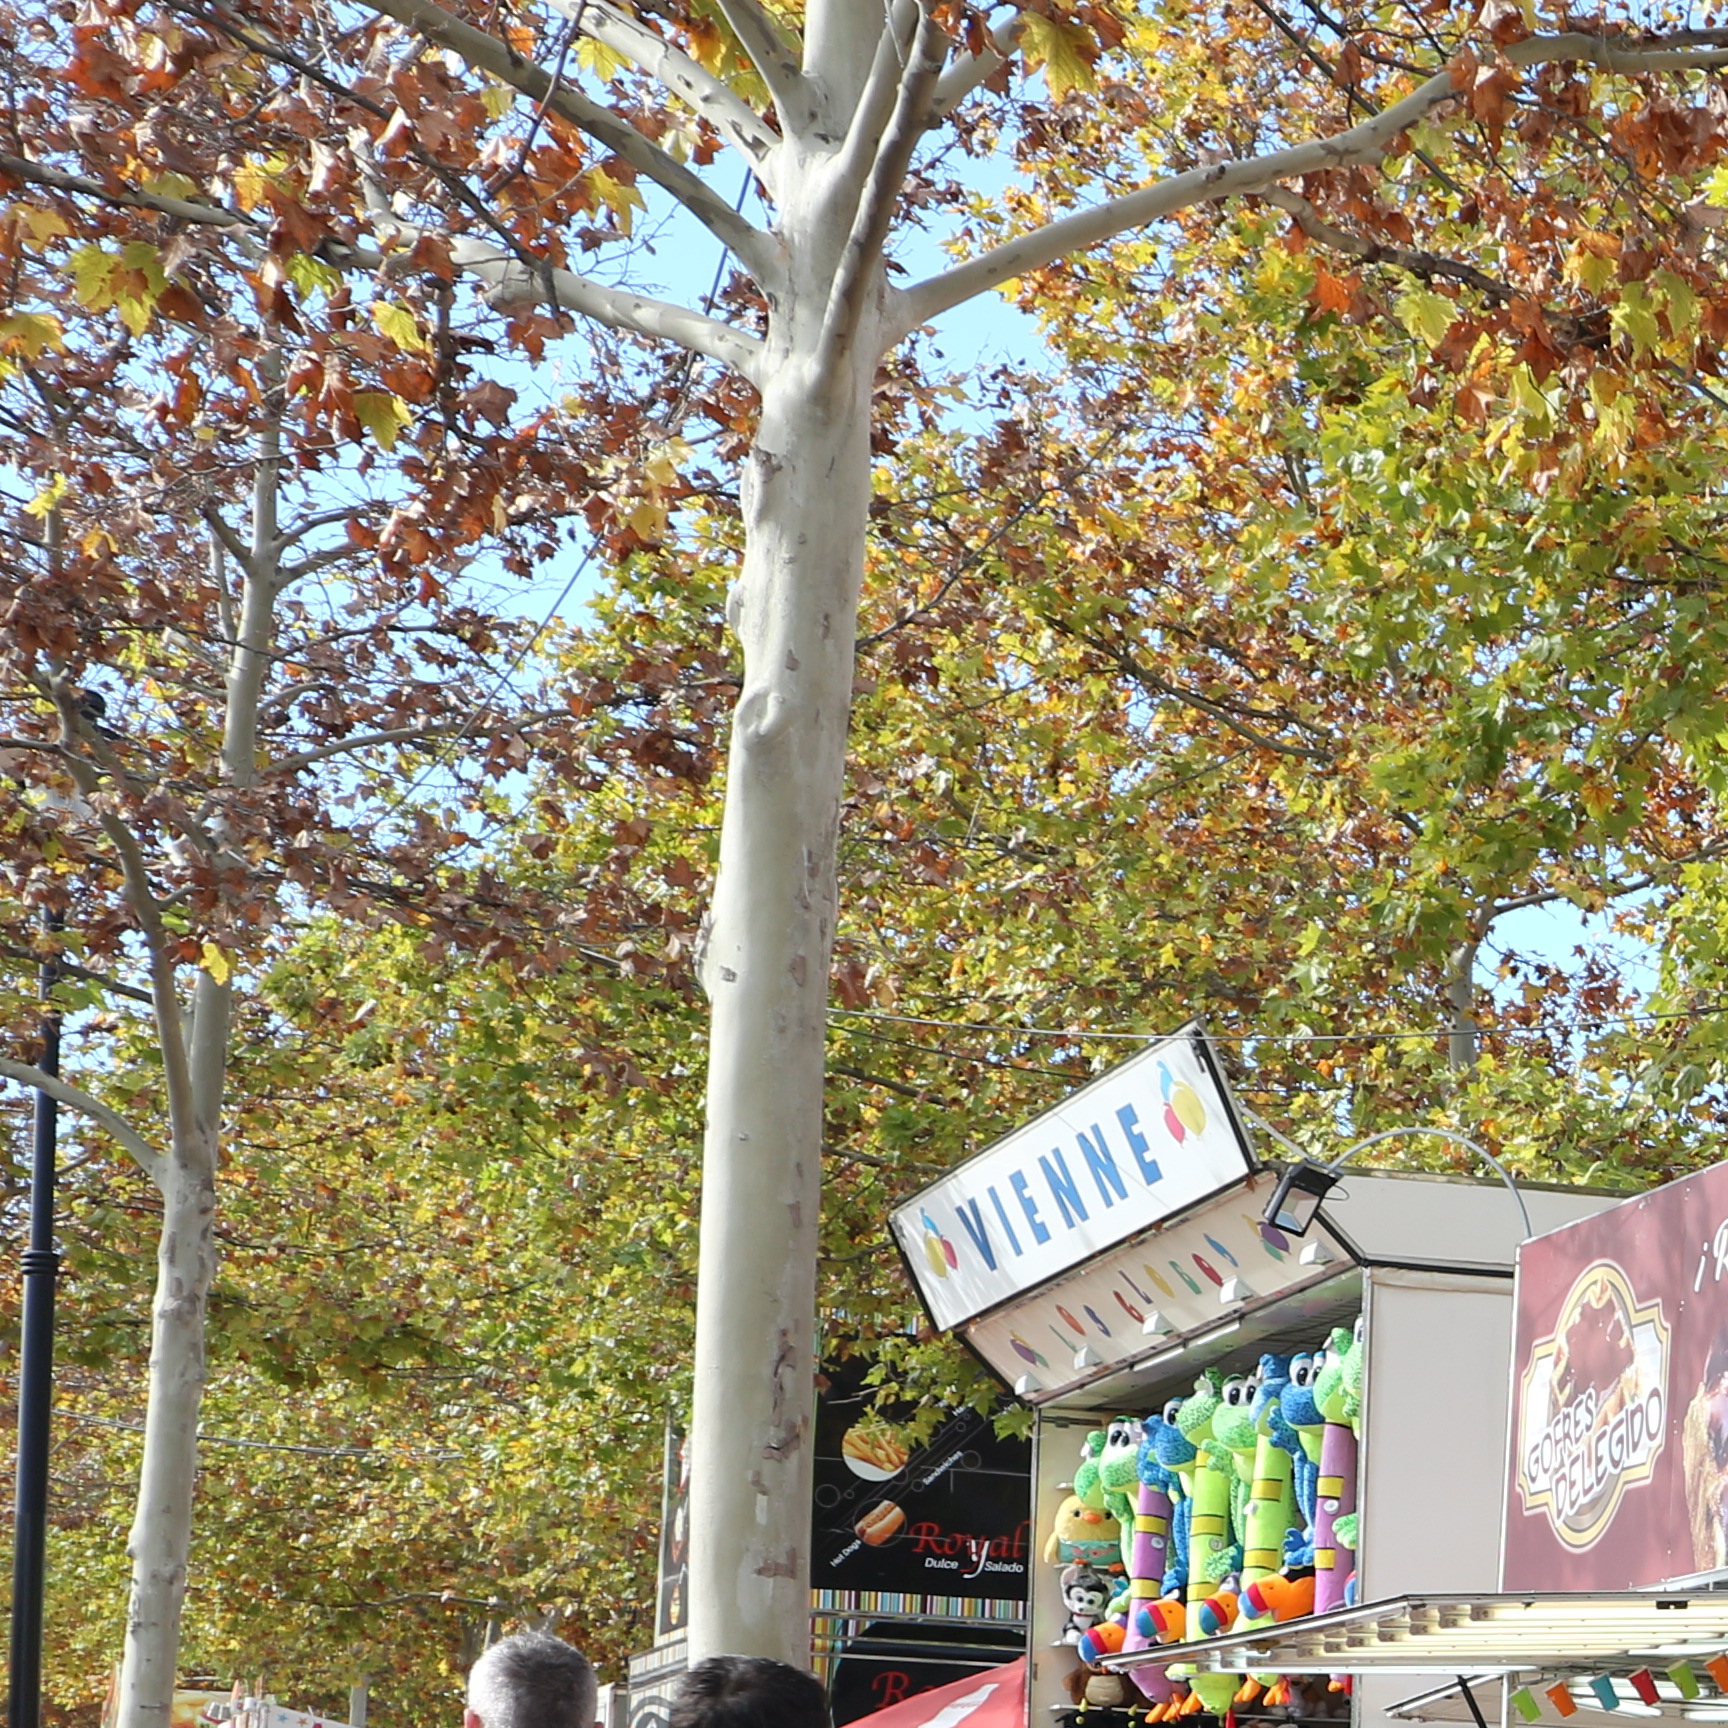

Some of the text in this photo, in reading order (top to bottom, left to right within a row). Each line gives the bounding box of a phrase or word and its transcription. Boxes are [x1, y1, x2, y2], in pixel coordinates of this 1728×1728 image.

[955, 1103, 1163, 1271] VIENNE
[1527, 1389, 1595, 1486] GOFRES
[1552, 1386, 1664, 1527] DELEGIDO
[921, 1450, 965, 1487] Sandwiches
[829, 1537, 862, 1568] Hot Dogs
[909, 1520, 1032, 1573] Royal
[924, 1557, 960, 1571] Dulce
[984, 1560, 1024, 1574] Salado
